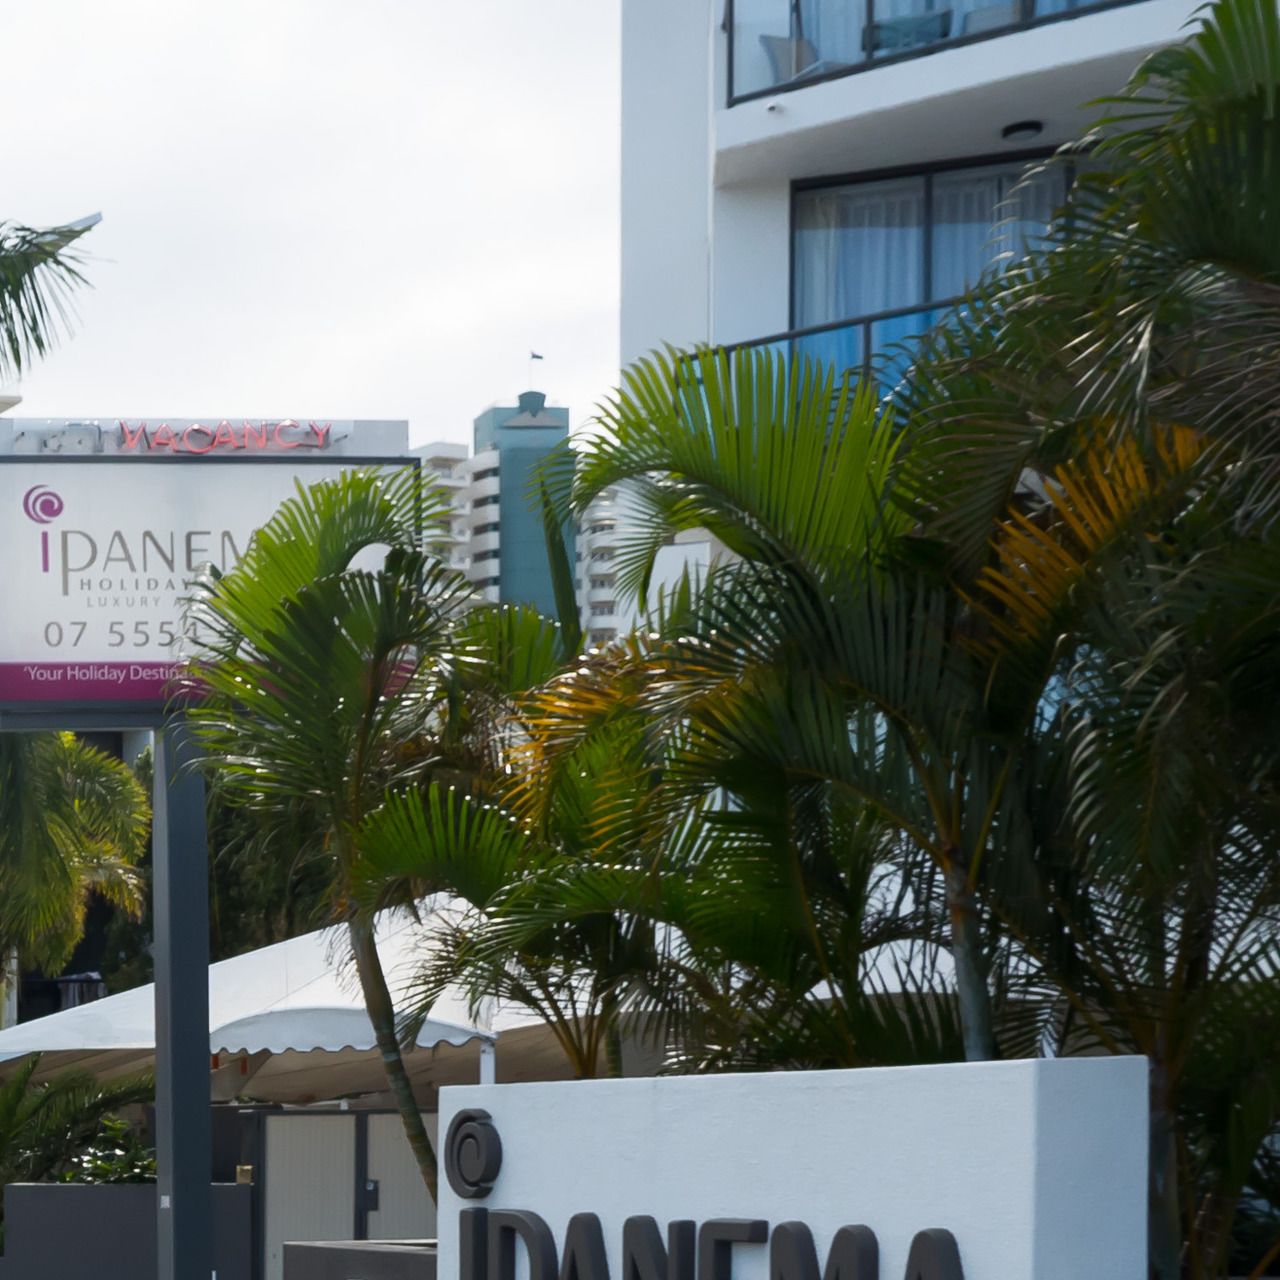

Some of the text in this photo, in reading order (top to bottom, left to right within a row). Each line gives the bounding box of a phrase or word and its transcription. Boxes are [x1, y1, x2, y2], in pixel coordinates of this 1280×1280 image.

[119, 419, 332, 454] VACANCY
[86, 596, 162, 608] LUXURY
[43, 620, 89, 648] 07
[66, 664, 128, 684] Holiday
